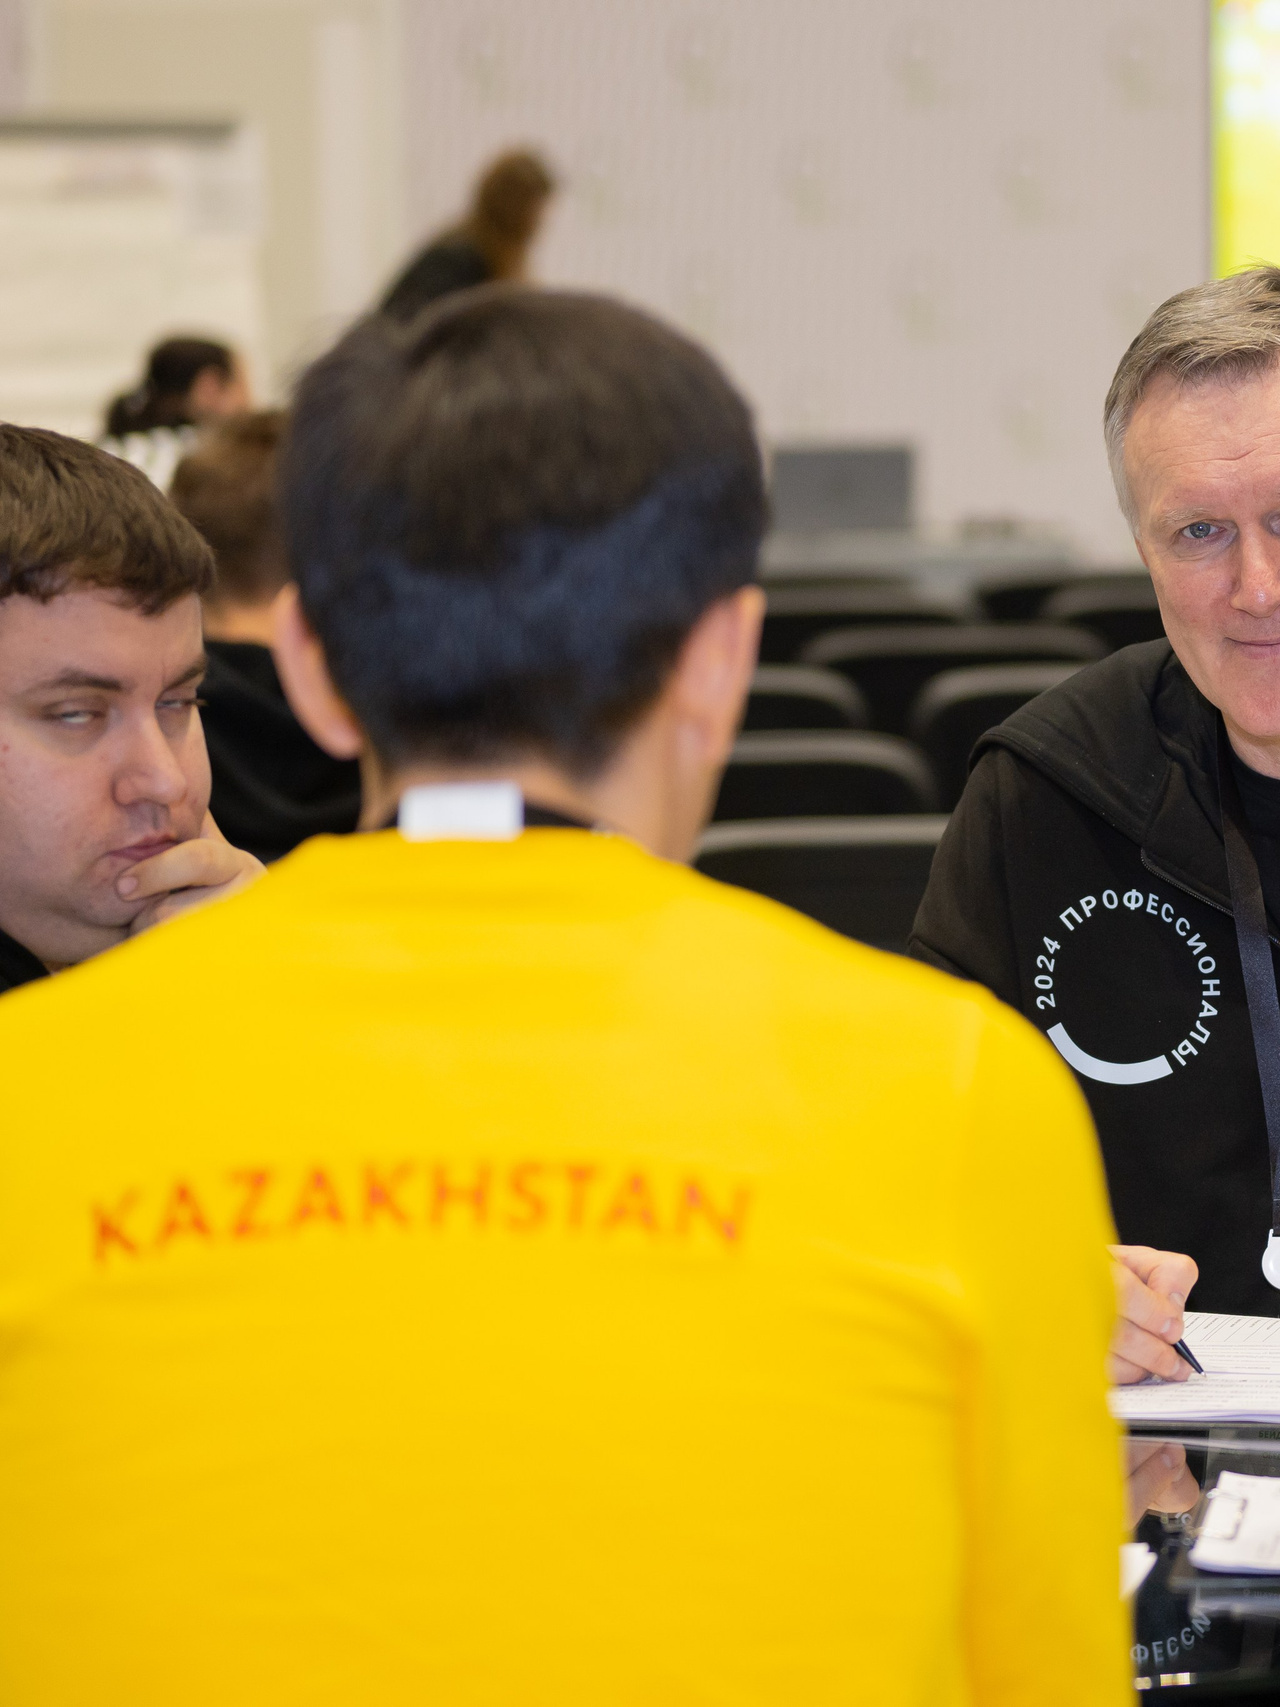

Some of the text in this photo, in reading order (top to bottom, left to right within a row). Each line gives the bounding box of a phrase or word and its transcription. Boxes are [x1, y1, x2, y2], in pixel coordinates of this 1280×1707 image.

[1034, 888, 1221, 1067] 2024 ПРОФЕССИОНАЛЫ
[86, 1158, 754, 1268] KAZAKHSTAN
